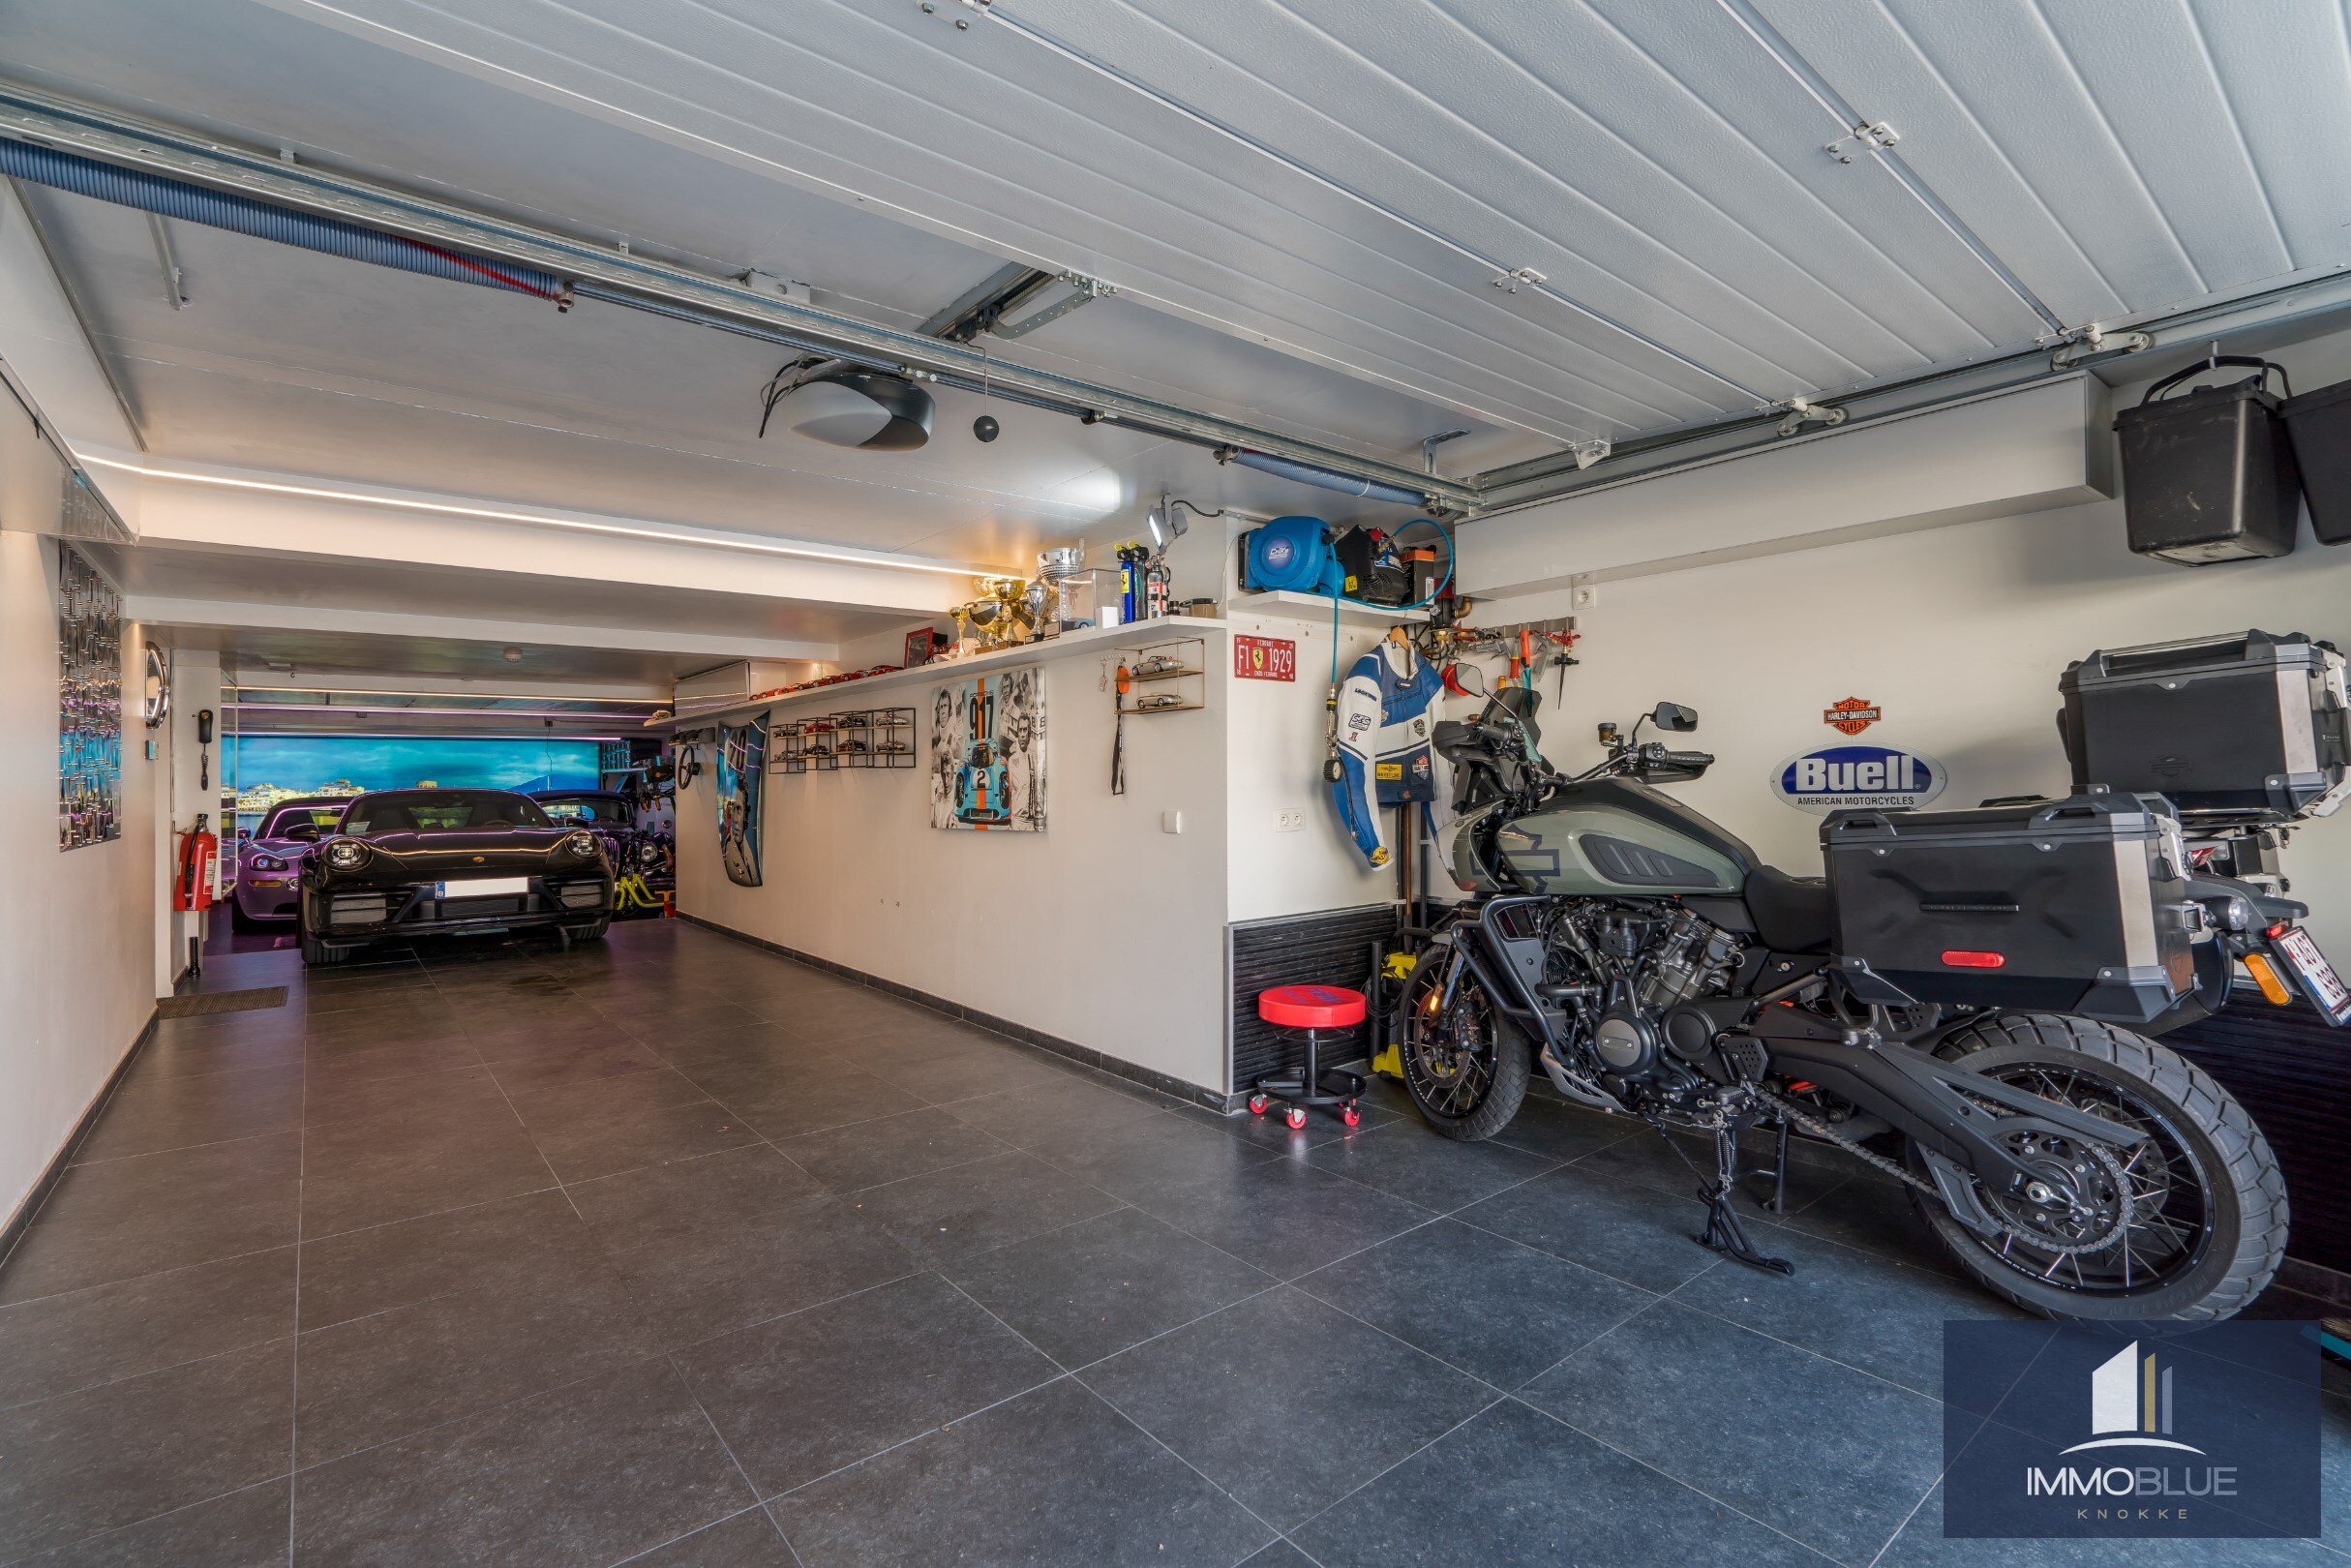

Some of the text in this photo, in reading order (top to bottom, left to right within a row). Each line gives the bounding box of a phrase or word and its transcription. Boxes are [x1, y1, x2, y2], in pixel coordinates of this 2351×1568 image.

[1238, 645, 1292, 673] F1 1929
[1838, 700, 1866, 709] MOTOR
[970, 696, 994, 739] 917
[1826, 709, 1879, 721] HARLEY-DAVIDSON
[1838, 720, 1866, 733] CYCLES
[977, 770, 986, 789] 2
[1795, 755, 1914, 792] Buell
[1797, 796, 1914, 806] AMERICAN MOTORCYCLES
